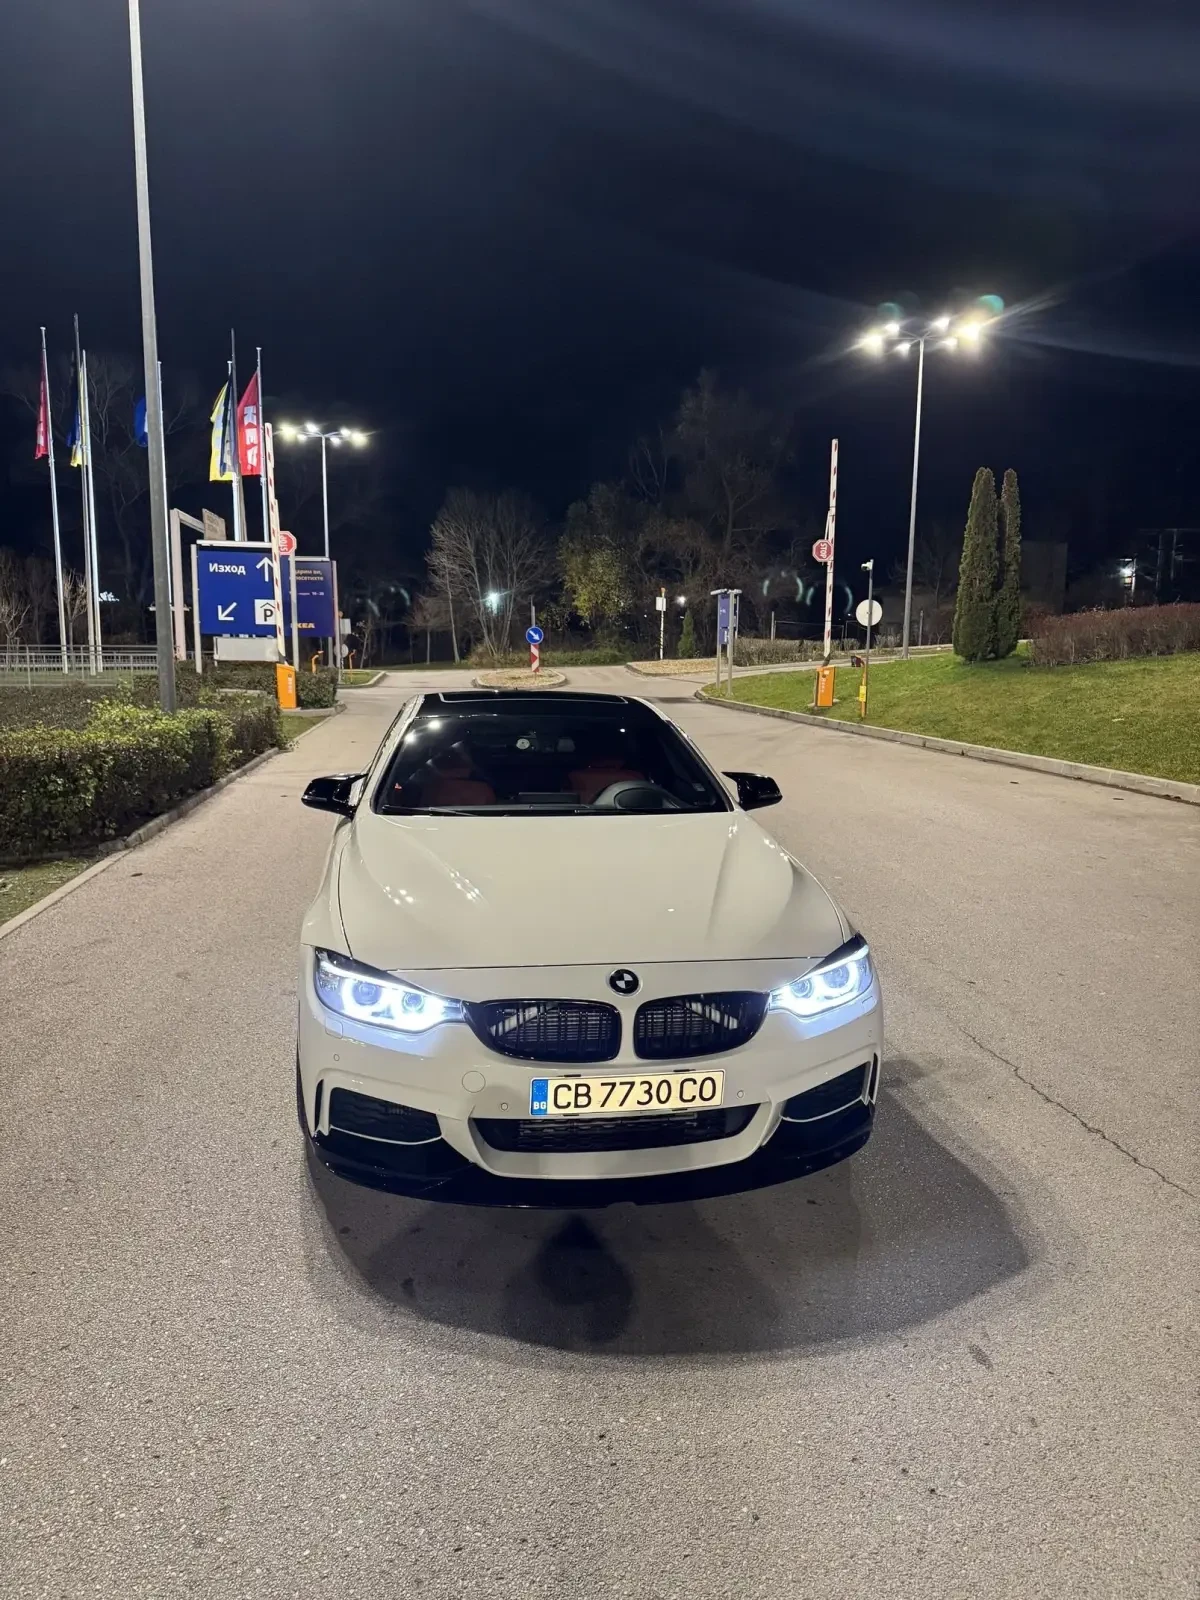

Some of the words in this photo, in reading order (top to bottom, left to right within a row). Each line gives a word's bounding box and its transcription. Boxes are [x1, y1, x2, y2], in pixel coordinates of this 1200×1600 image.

[244, 405, 258, 467] KEA
[280, 534, 288, 552] STOP
[819, 543, 828, 559] STOP
[209, 563, 246, 576] Изход
[264, 608, 274, 622] P
[553, 1083, 592, 1110] CB
[598, 1079, 672, 1108] 7730
[679, 1076, 716, 1103] CO
[533, 1101, 547, 1110] BG
